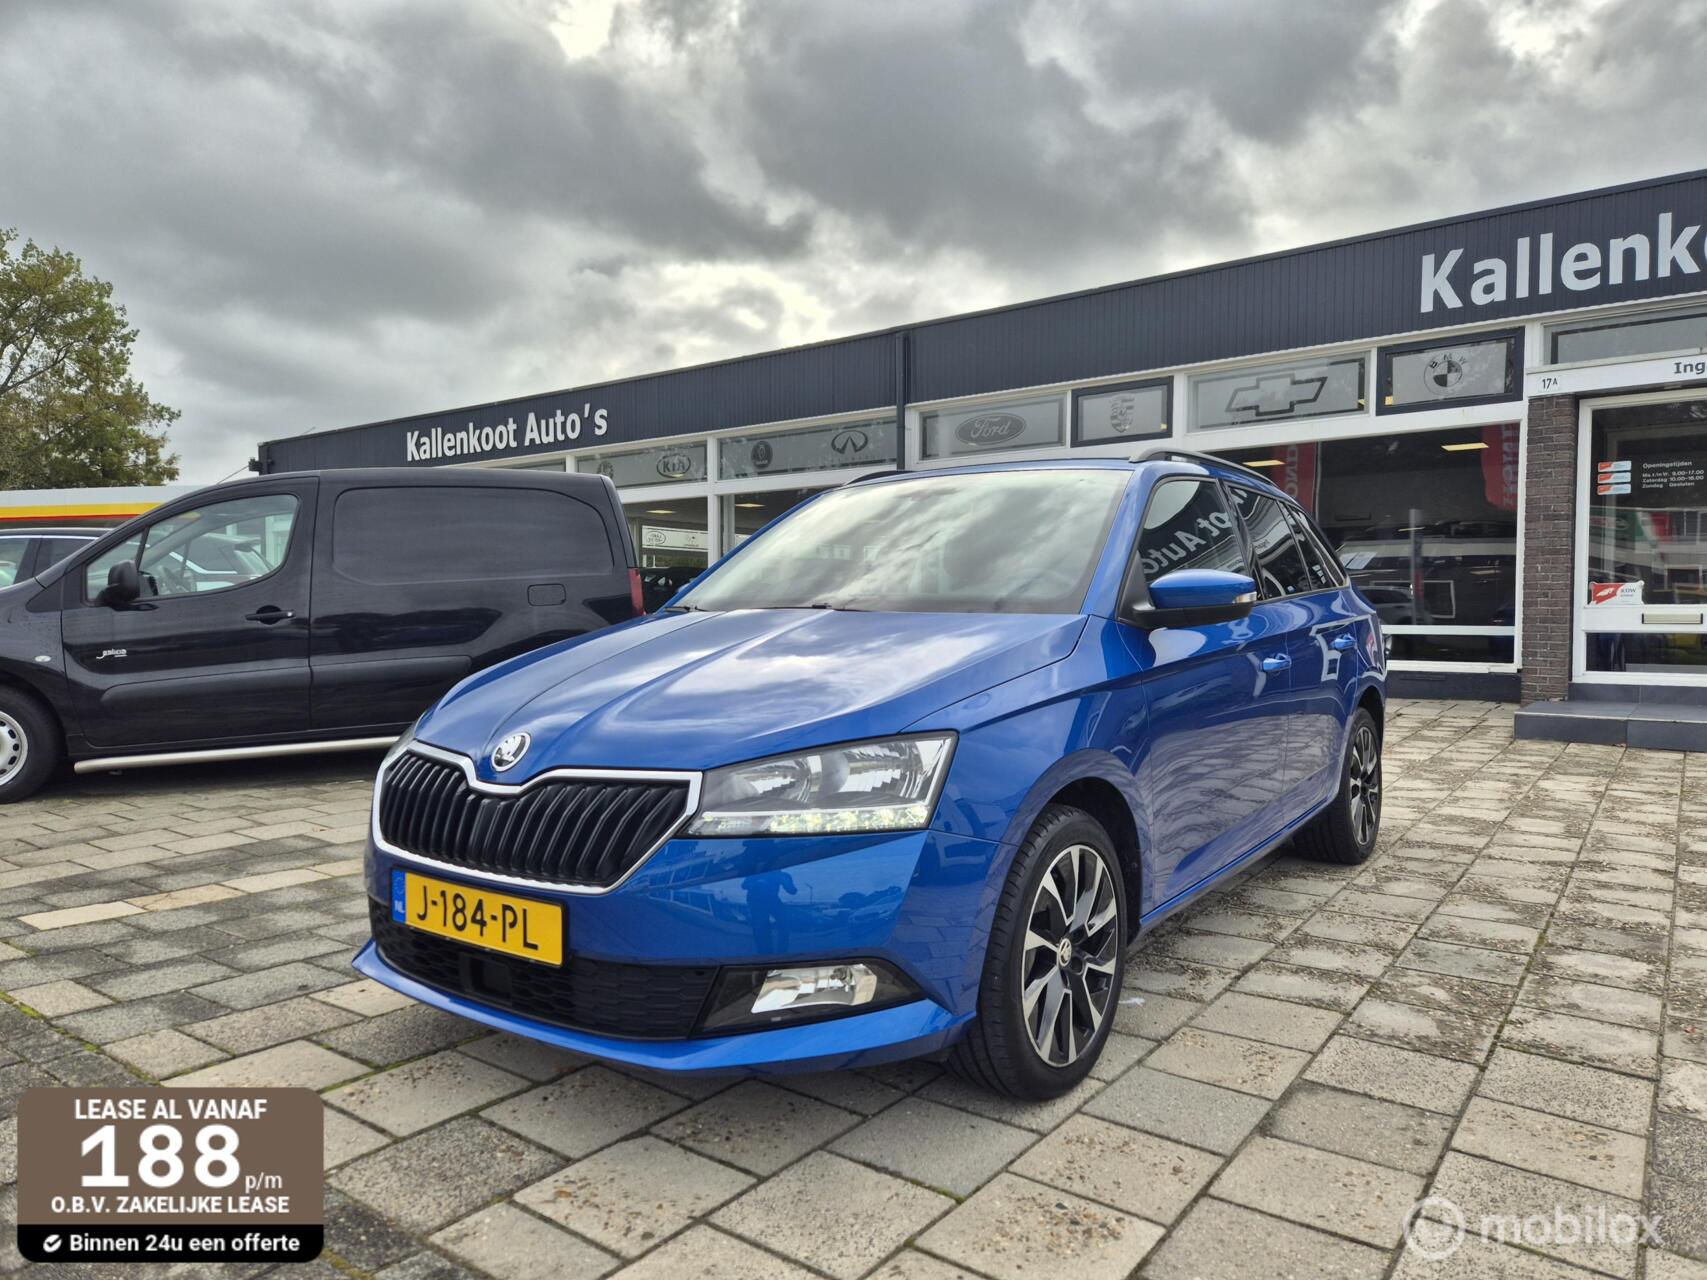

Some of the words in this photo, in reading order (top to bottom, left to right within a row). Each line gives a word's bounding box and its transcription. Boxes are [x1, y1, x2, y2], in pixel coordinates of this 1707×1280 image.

[1420, 212, 1707, 313] Kallenk
[1674, 361, 1706, 375] Ing
[406, 417, 517, 462] Kallenkoot
[524, 403, 608, 446] Auto's
[970, 419, 1011, 438] Ford
[1642, 461, 1693, 469] Openingstijden
[416, 885, 539, 951] J-184-PL
